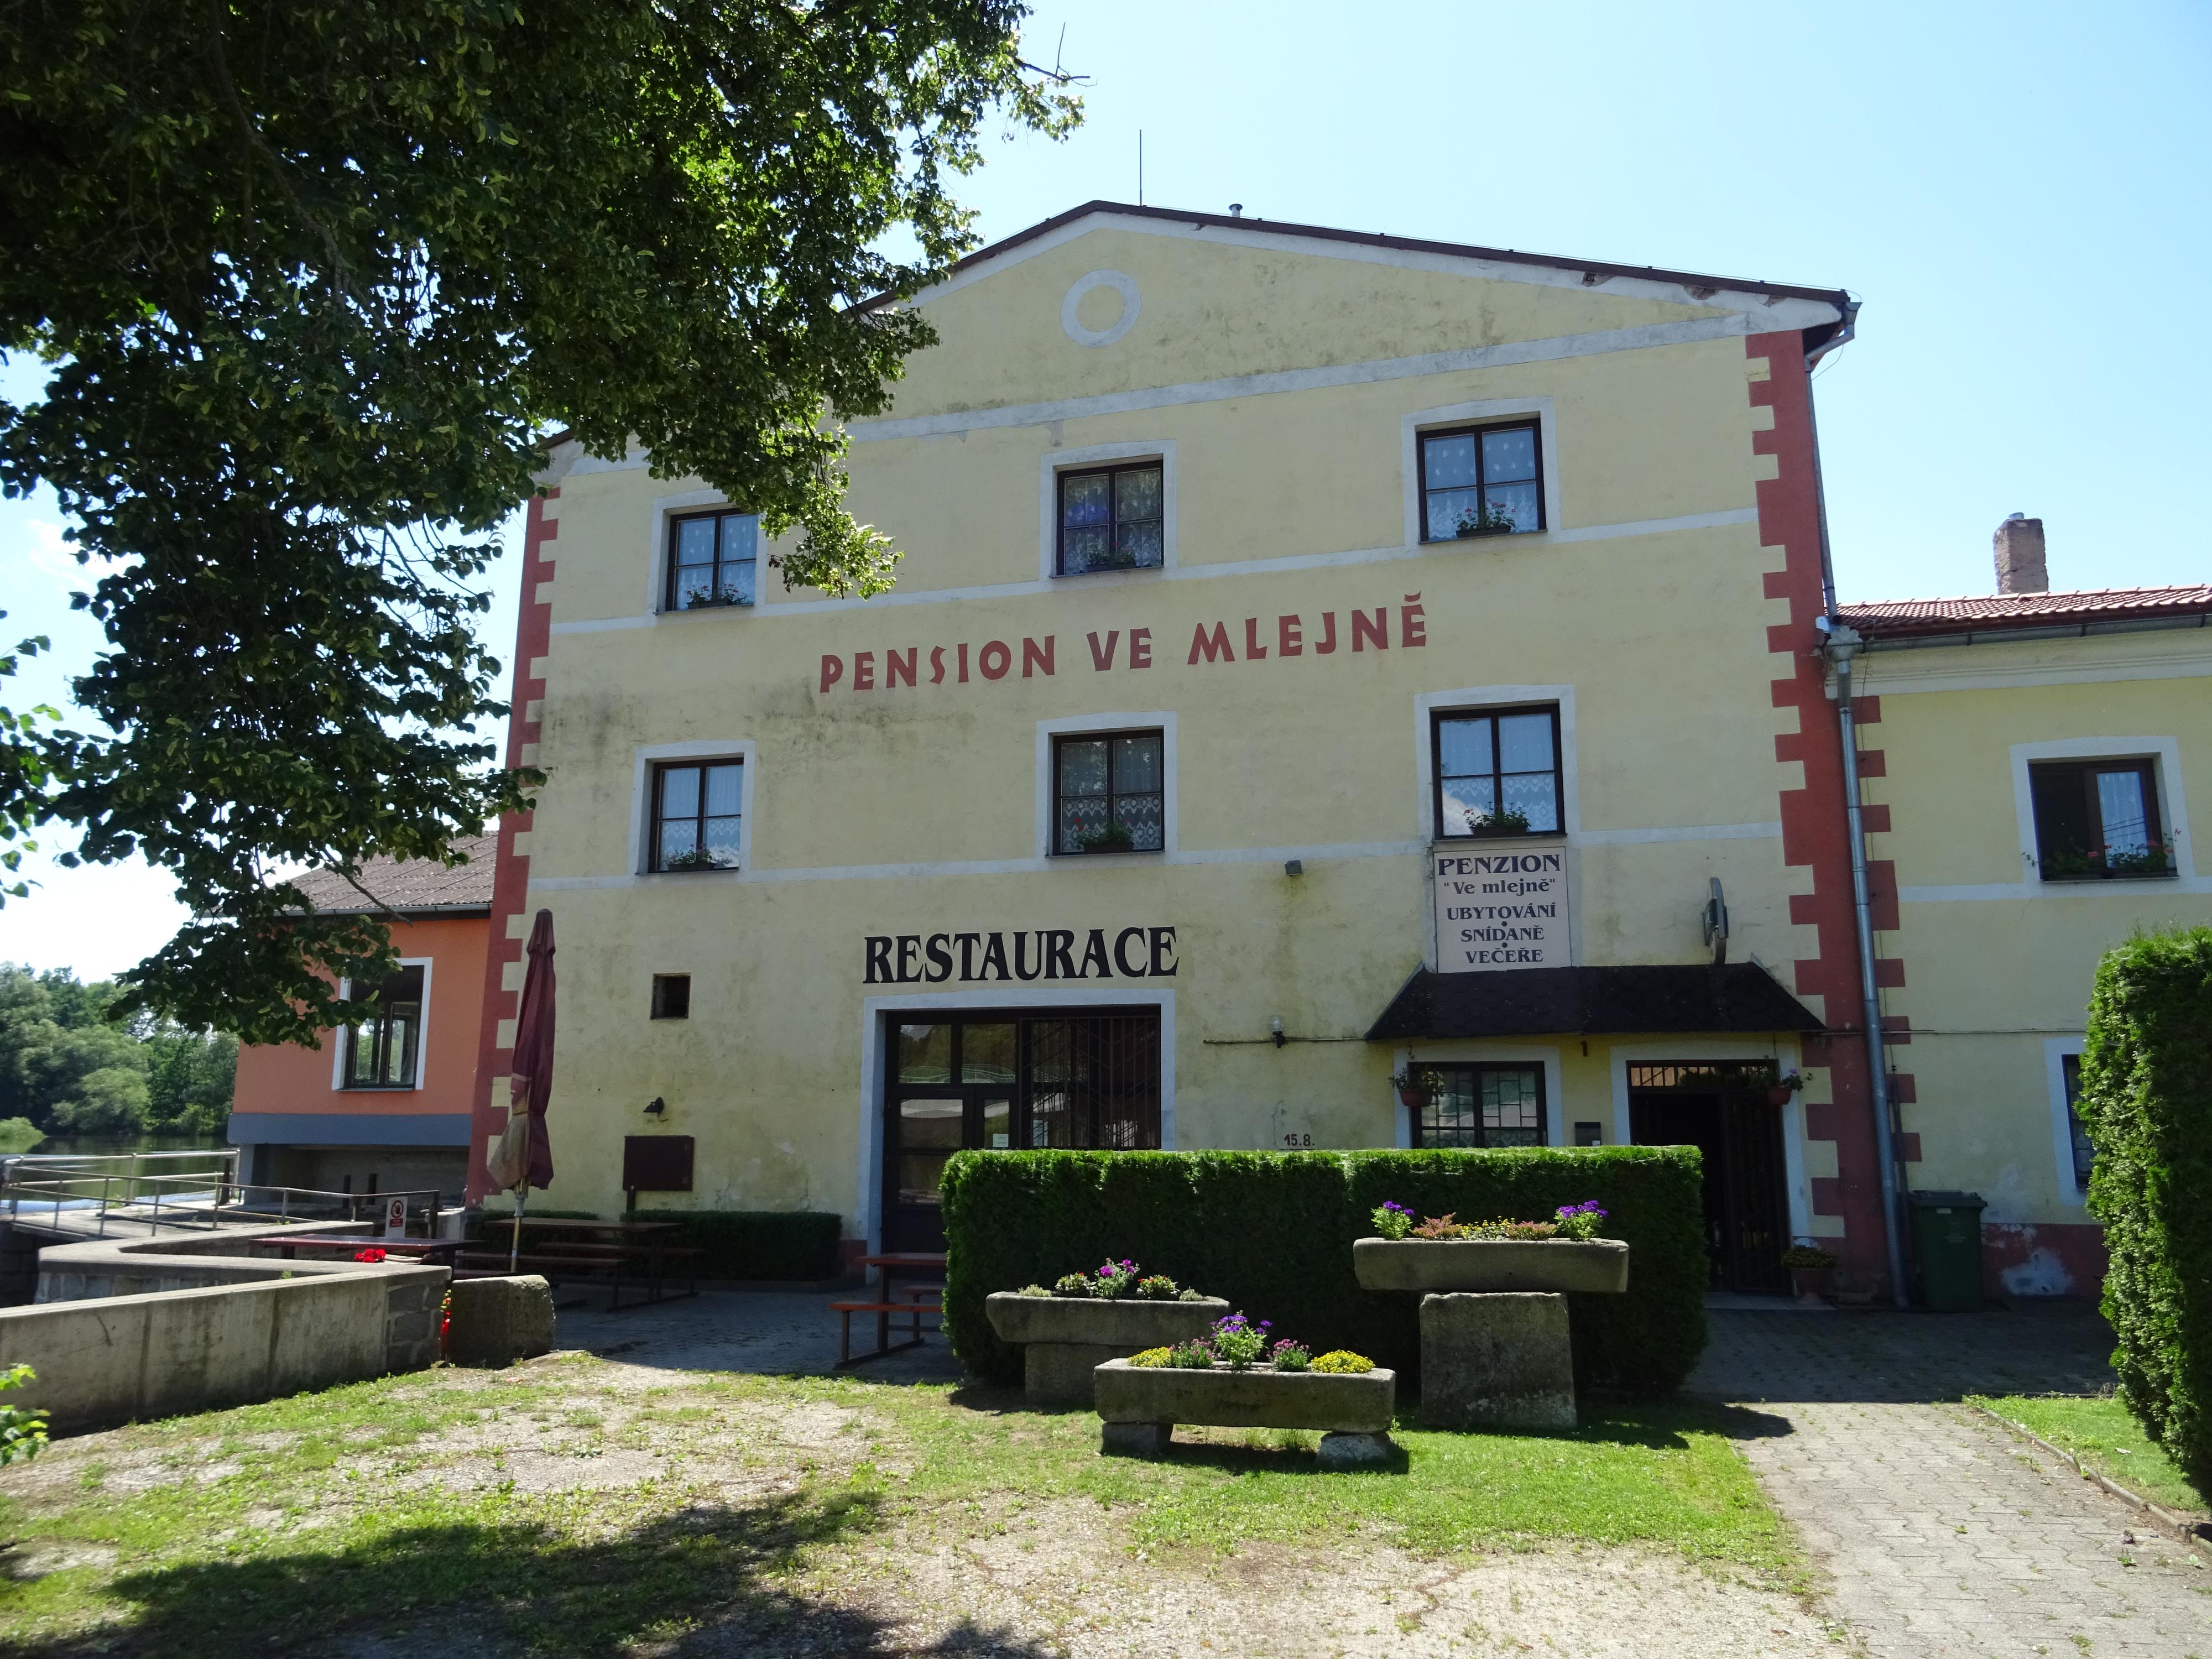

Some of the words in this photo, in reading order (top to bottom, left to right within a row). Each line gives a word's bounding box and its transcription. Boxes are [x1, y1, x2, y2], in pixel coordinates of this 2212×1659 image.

[820, 635, 1055, 693] PENSION
[1087, 628, 1152, 671] VE
[1187, 591, 1426, 665] MLEJNĚ
[1438, 854, 1561, 875] PENZION
[1482, 878, 1555, 896] mlejně"
[1447, 902, 1556, 920] UBYTOVÁNÍ
[1460, 925, 1545, 942] SNÍDANĚ
[863, 926, 1179, 984] RESTAURACE
[1465, 947, 1543, 963] VEČEŘE
[1284, 1134, 1315, 1146] 15.8.
